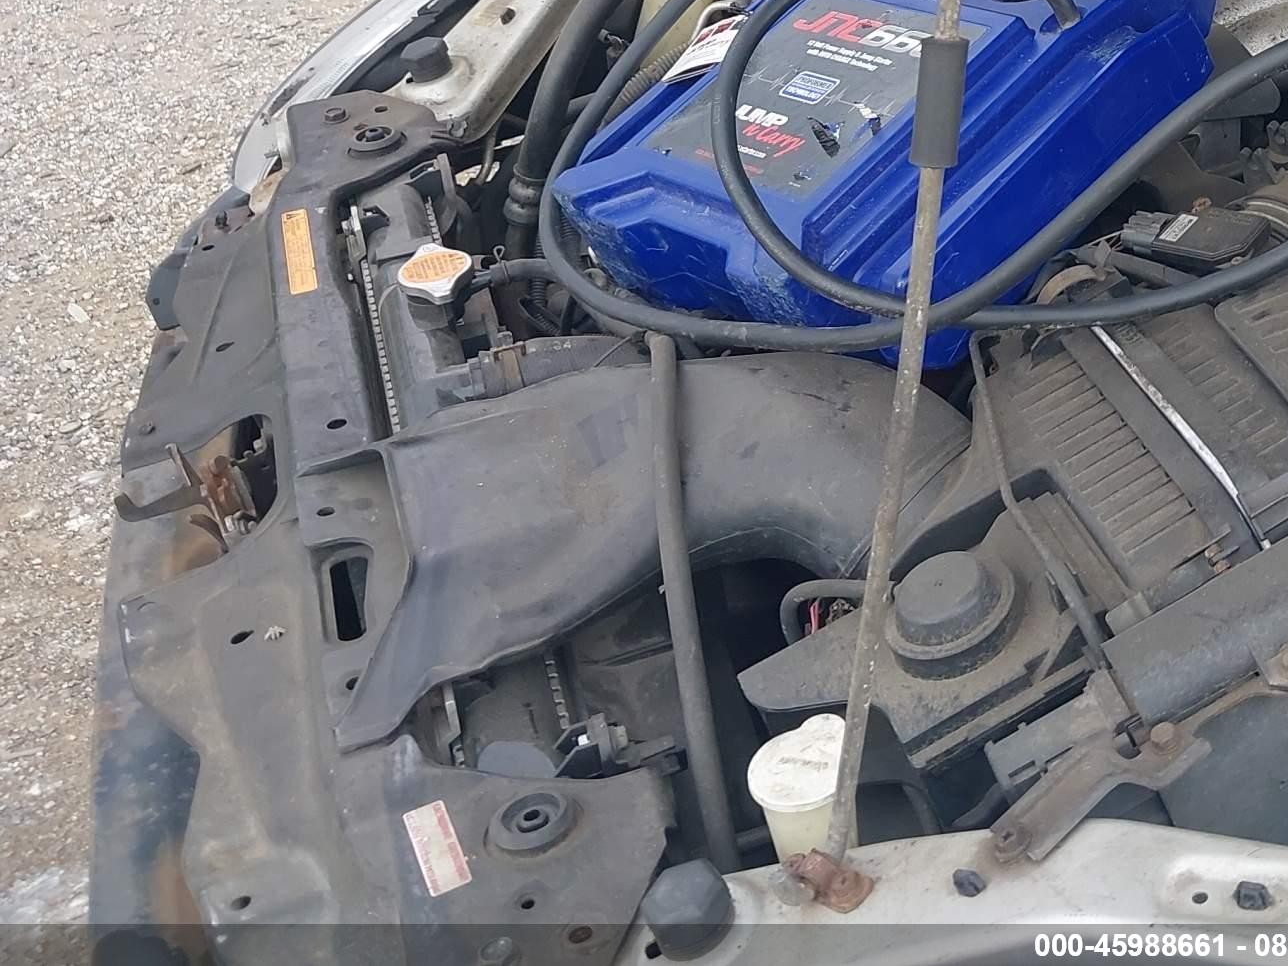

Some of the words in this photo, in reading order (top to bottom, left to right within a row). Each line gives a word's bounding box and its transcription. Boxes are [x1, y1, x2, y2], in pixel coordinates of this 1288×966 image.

[792, 10, 931, 58] JNC66
[735, 104, 789, 127] UMP
[756, 126, 806, 157] Carry
